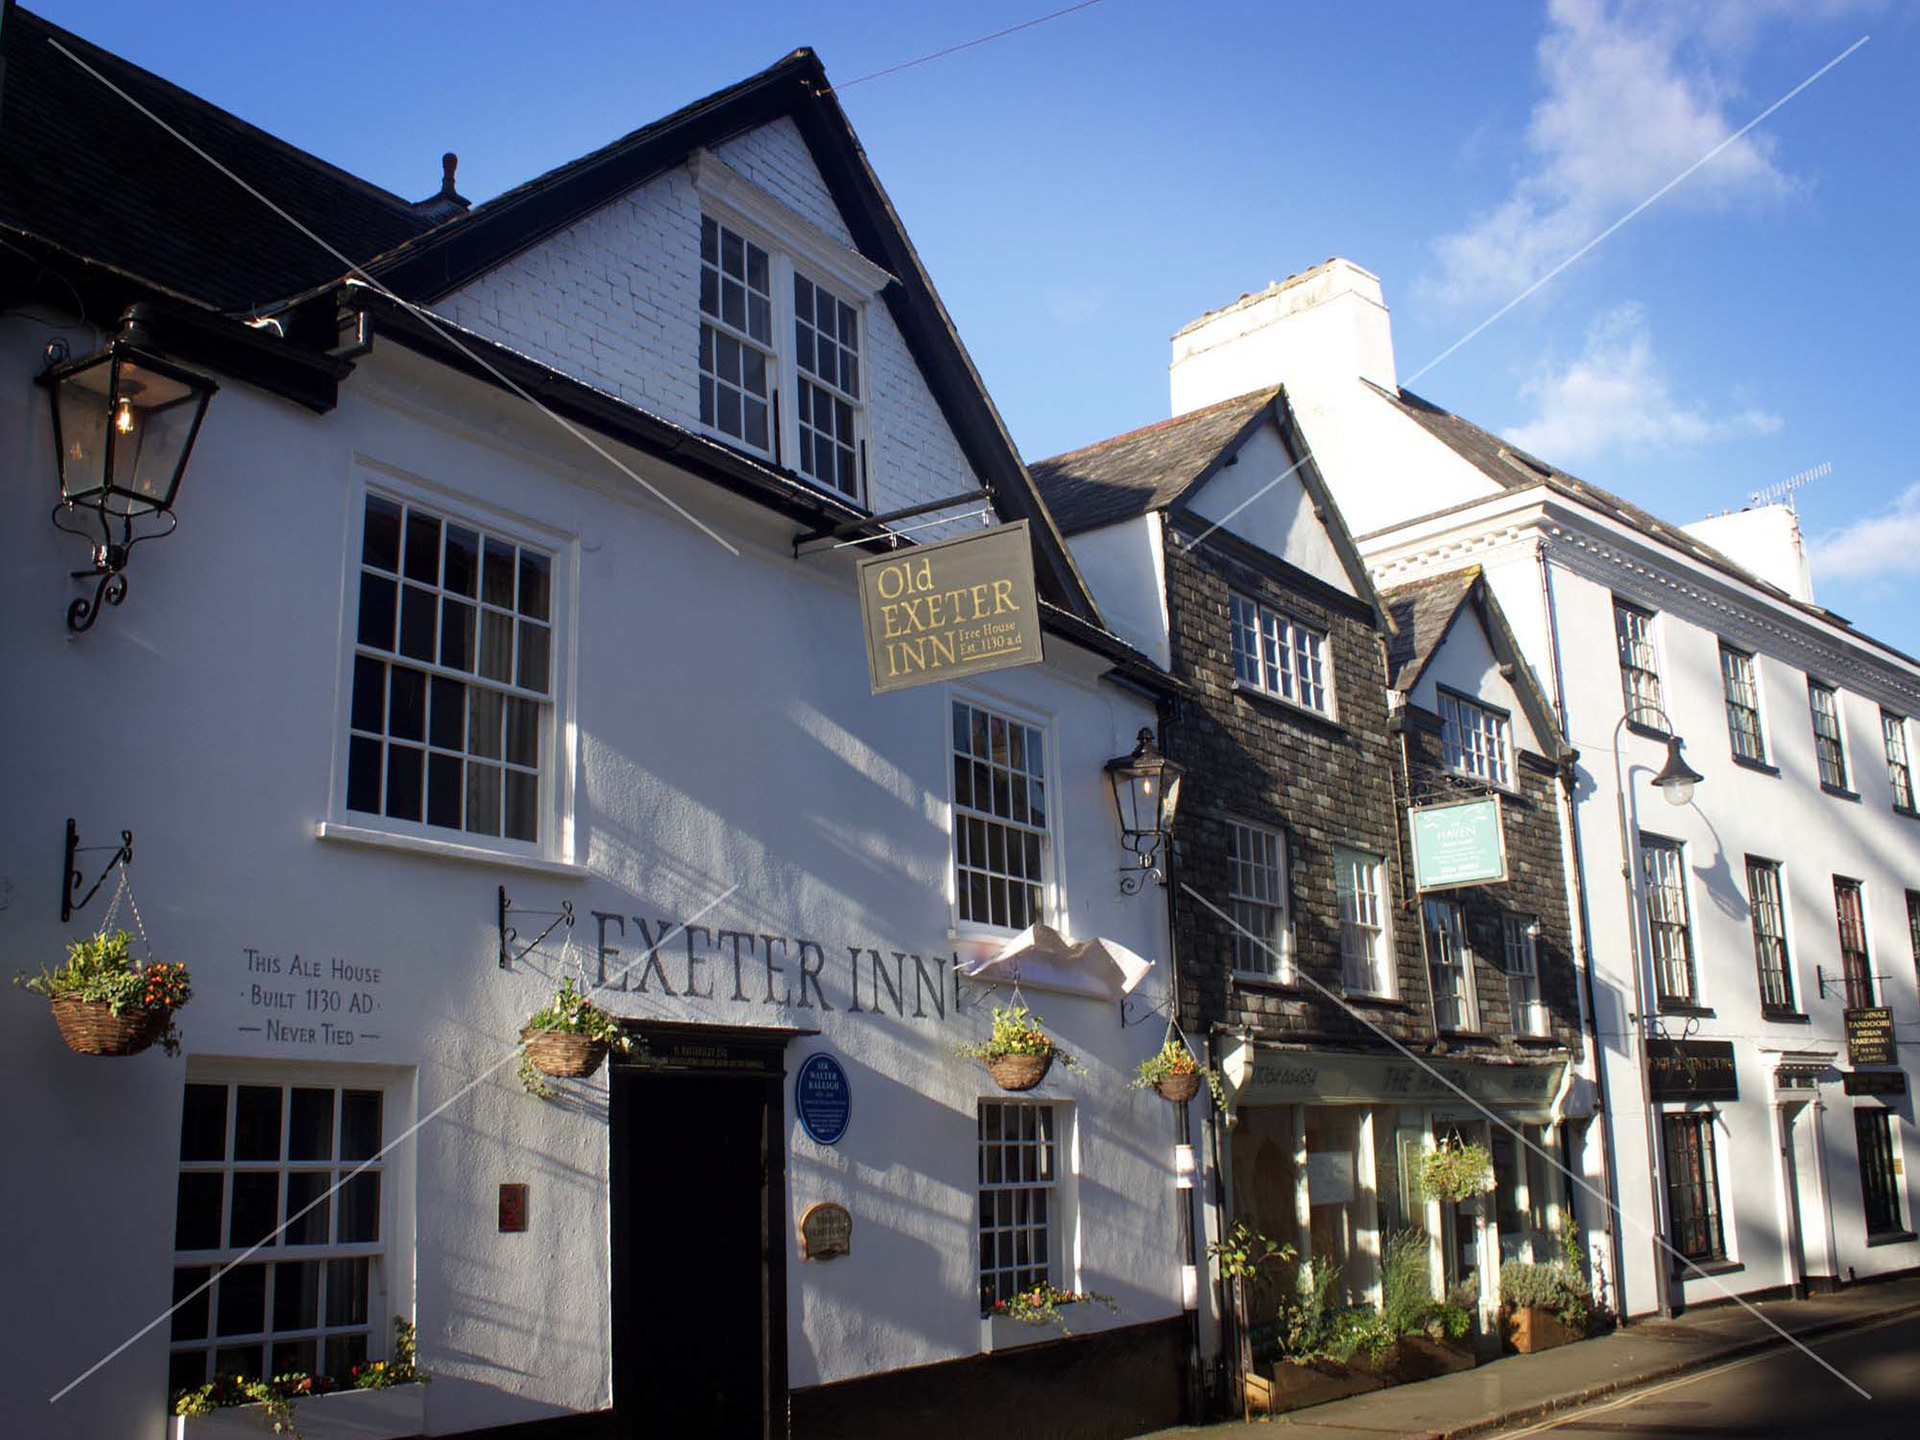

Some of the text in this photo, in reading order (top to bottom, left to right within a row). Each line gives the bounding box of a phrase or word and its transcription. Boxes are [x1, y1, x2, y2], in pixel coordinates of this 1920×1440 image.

[878, 558, 934, 599] Old
[881, 580, 1020, 638] EXETER
[960, 622, 1016, 642] Free House
[886, 631, 956, 677] INN
[332, 957, 381, 984] HOUSE
[591, 910, 947, 1021] EXETER INN
[251, 983, 374, 1015] BUILT 1130 AD
[266, 1019, 354, 1046] NEVER TIED
[1848, 1019, 1890, 1029] TANDOORI
[808, 1080, 840, 1091] RALEIGH
[809, 1071, 838, 1081] WALTER
